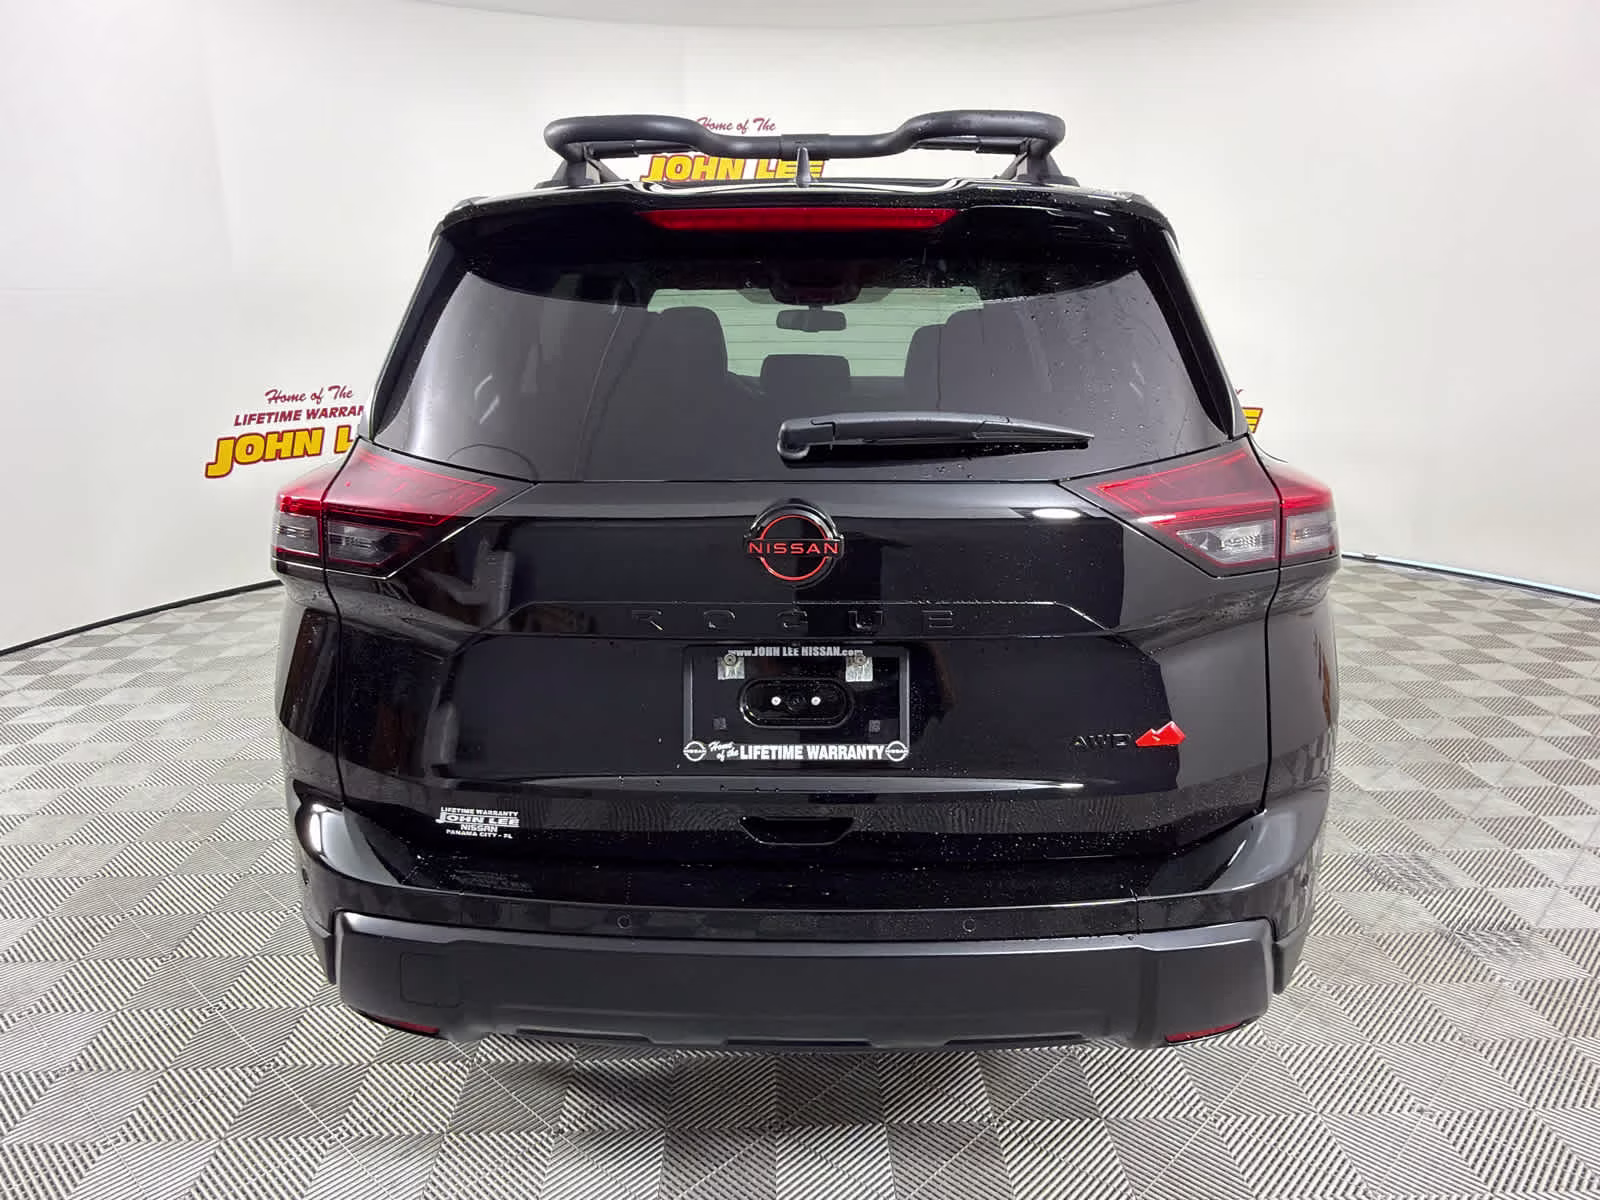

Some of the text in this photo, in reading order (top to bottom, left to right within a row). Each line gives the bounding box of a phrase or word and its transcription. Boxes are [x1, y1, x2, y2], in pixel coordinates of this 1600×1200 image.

[697, 117, 776, 134] Home of The
[640, 154, 824, 182] JOHN LEE
[265, 385, 353, 404] Home of The
[234, 410, 302, 426] LIFETIME
[205, 427, 325, 478] JOHN
[749, 543, 839, 555] NISSAN
[631, 609, 954, 631] ROGUE
[783, 648, 799, 657] LEE
[708, 741, 735, 752] Home
[1072, 733, 1132, 748] AWD
[740, 745, 885, 760] LIFETIME WARRANTY
[435, 812, 520, 827] JOHN LEE
[460, 824, 498, 832] NISSAN
